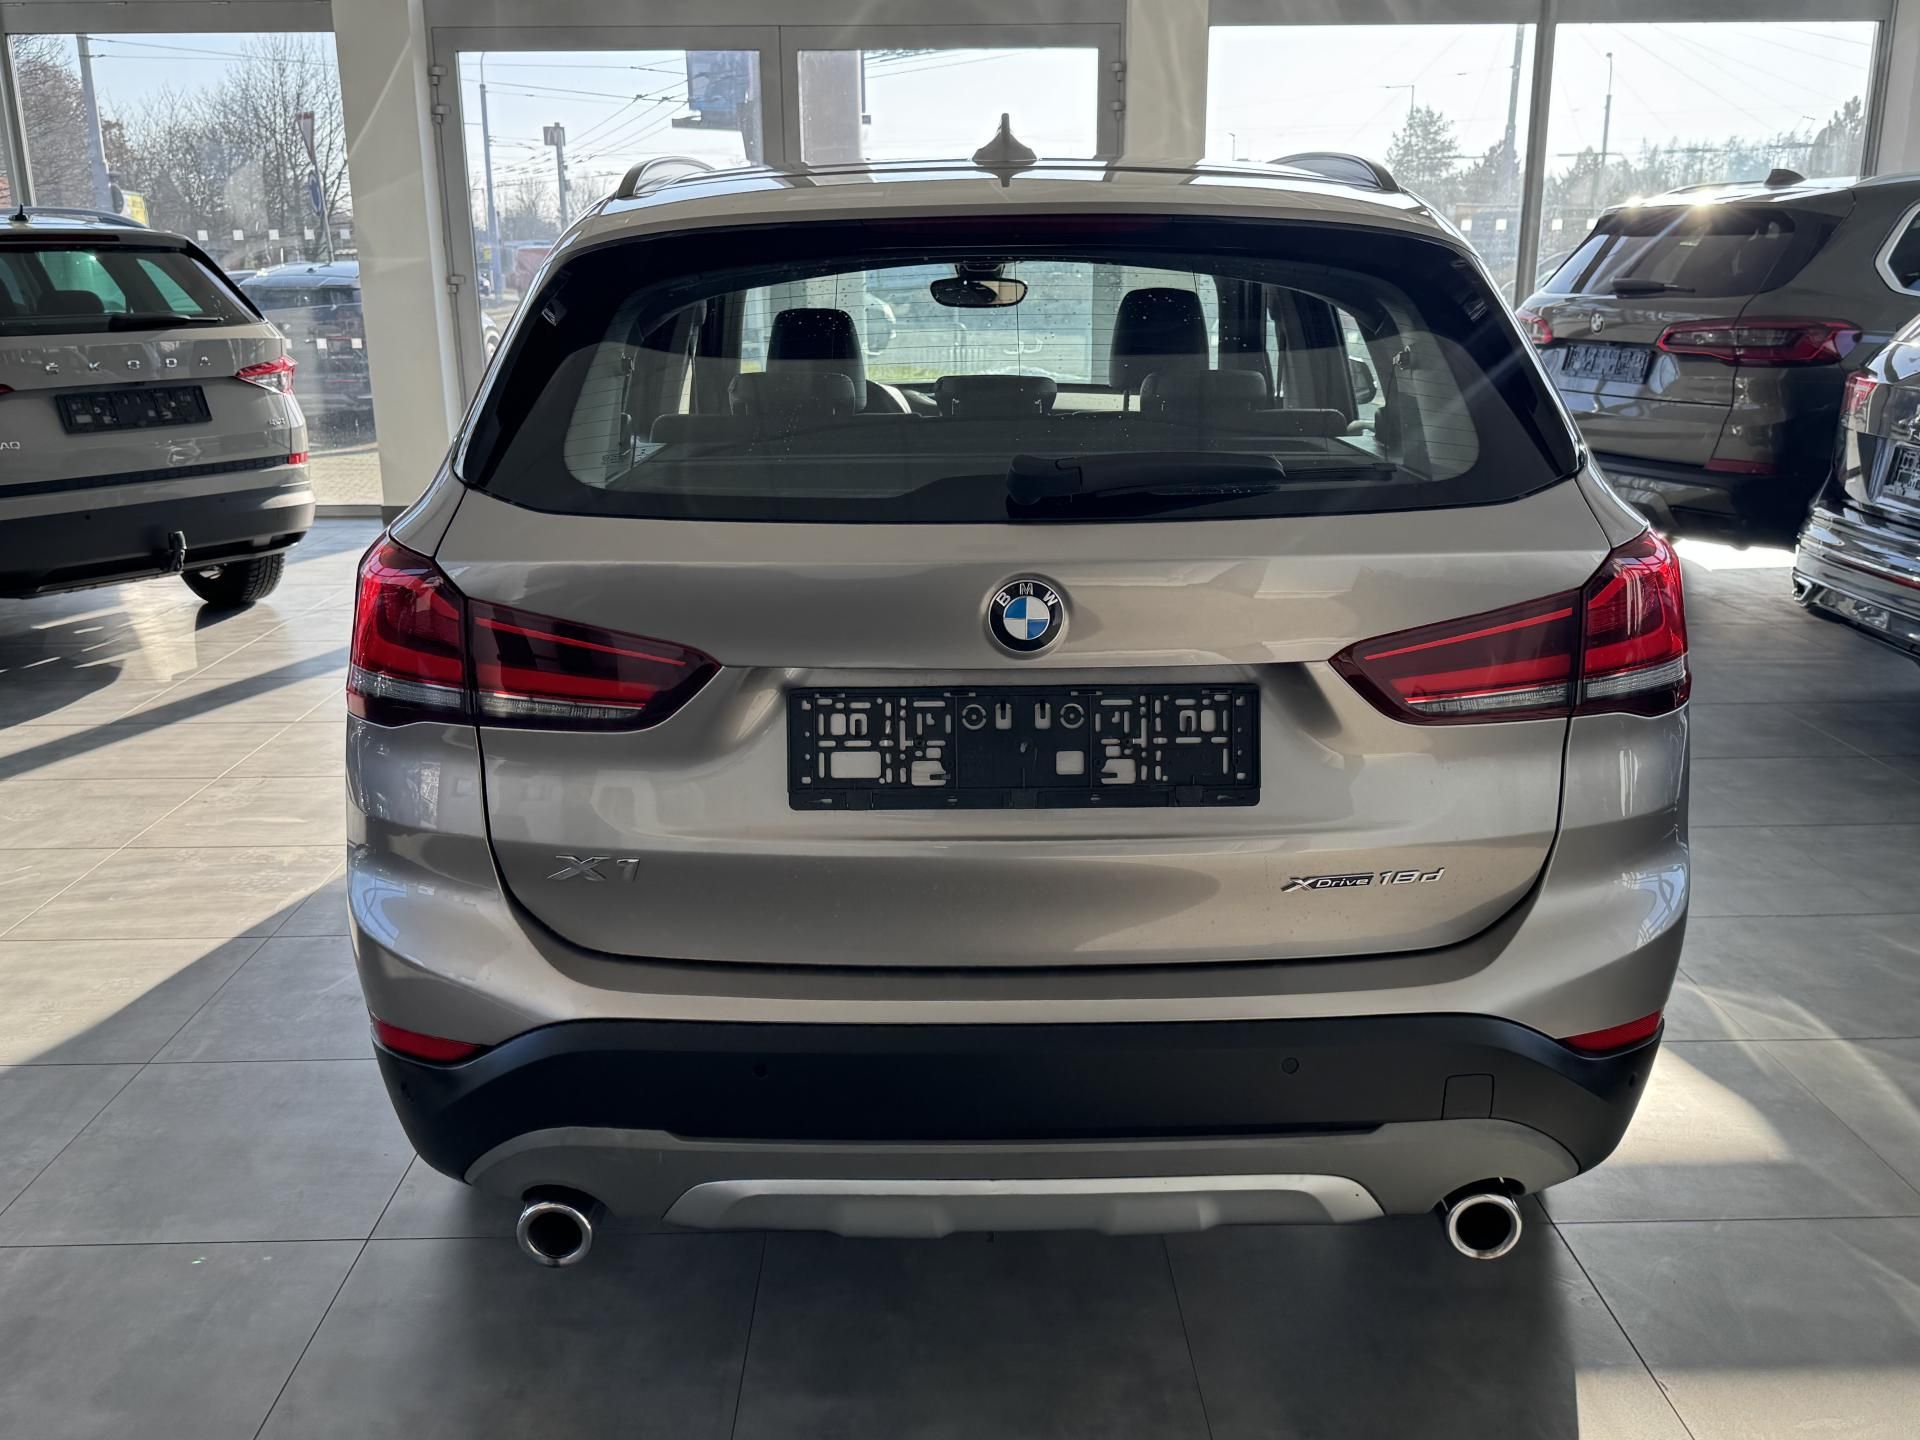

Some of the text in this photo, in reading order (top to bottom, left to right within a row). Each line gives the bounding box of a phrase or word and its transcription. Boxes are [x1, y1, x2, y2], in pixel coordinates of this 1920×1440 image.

[996, 583, 1059, 607] BMW
[546, 855, 640, 881] X1
[1380, 867, 1447, 887] 18d
